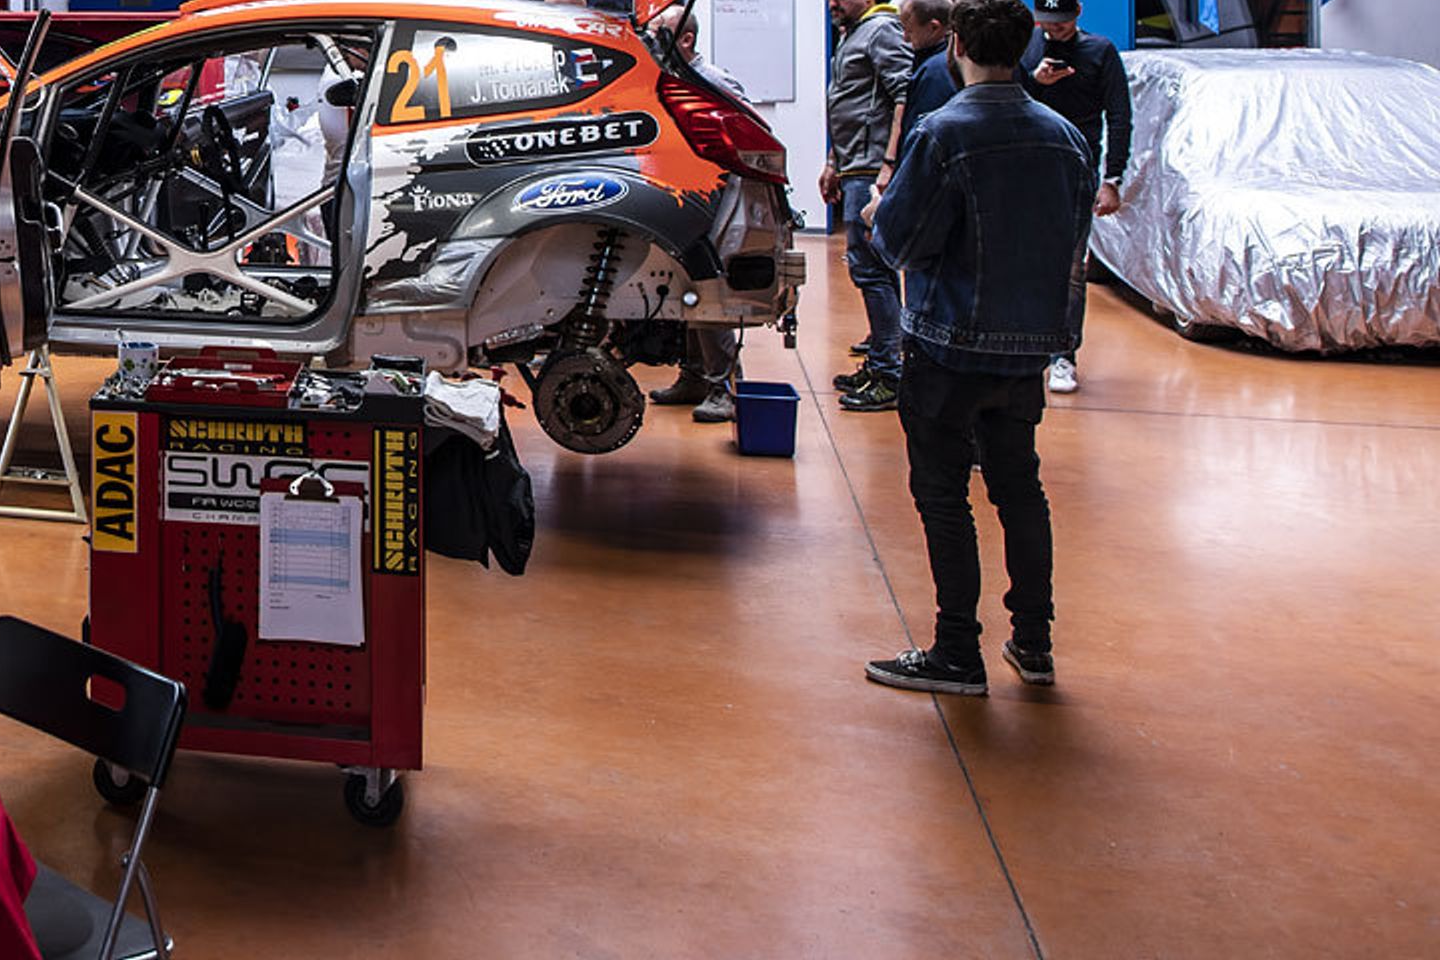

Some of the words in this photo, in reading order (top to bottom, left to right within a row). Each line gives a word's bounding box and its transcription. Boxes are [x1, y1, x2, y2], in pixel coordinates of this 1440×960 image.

[386, 47, 452, 123] 21
[471, 85, 486, 103] J.
[491, 76, 570, 100] Tománek
[514, 120, 643, 150] ONEBET
[511, 181, 605, 211] Ford
[169, 420, 303, 443] SCHROTH
[170, 442, 303, 455] RACING
[96, 424, 135, 542] ADAC
[220, 498, 259, 510] WOR
[384, 430, 405, 571] SCHROTH
[408, 431, 418, 572] RACING
